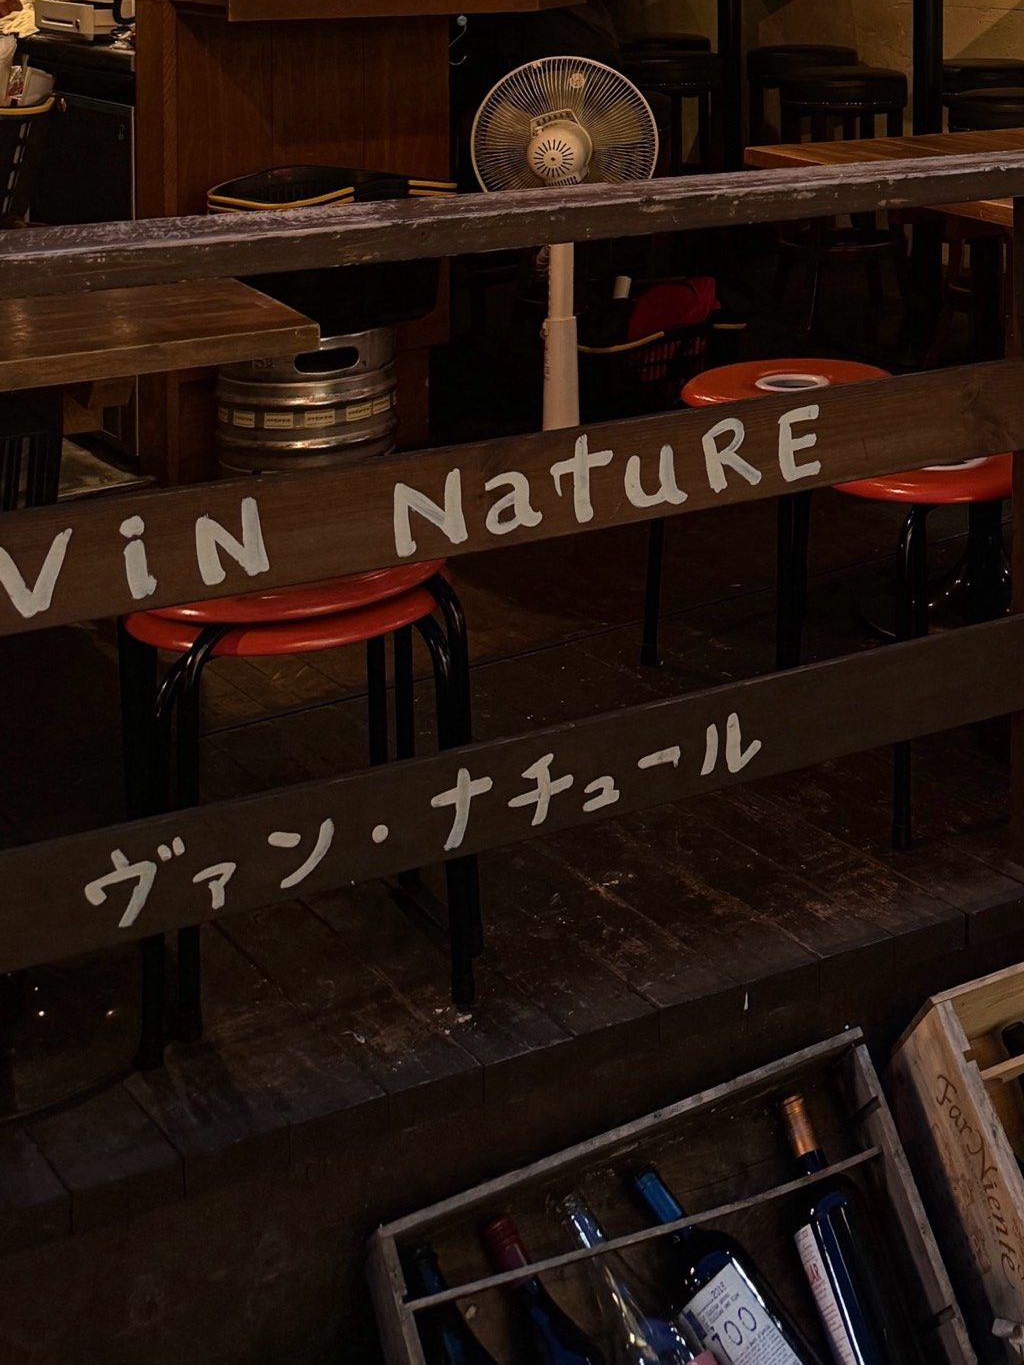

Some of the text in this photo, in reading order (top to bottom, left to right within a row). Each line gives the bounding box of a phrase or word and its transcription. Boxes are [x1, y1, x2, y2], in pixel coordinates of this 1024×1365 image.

[84, 711, 763, 929] ヴァン・ナチュール
